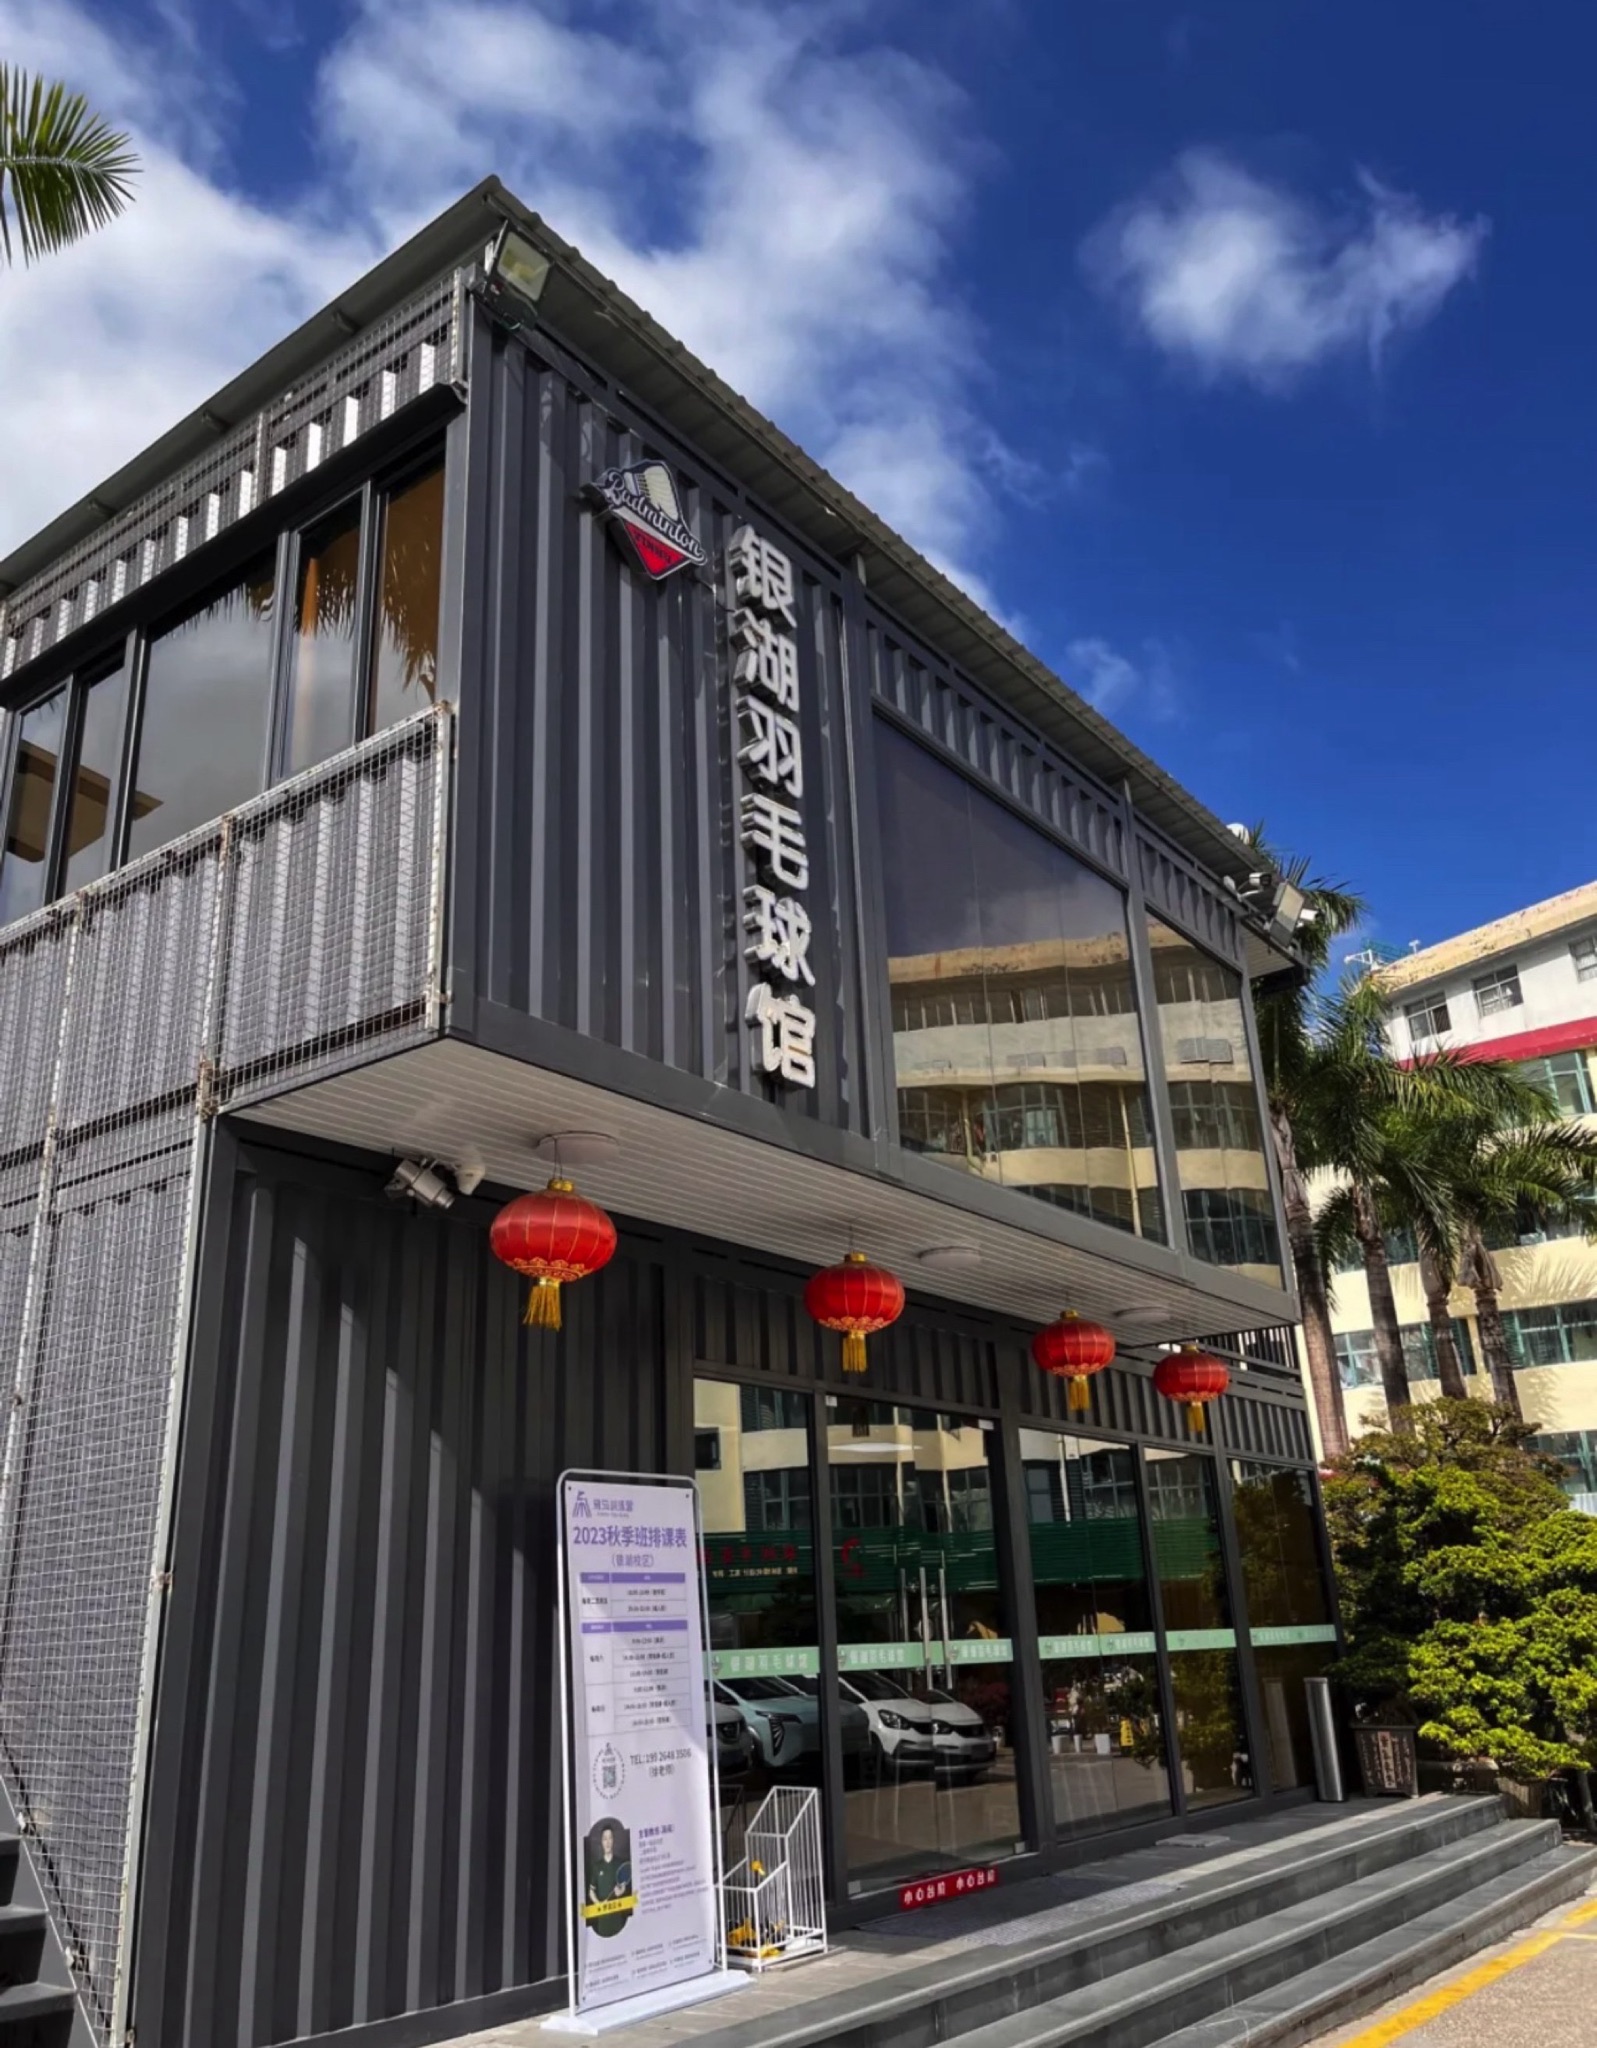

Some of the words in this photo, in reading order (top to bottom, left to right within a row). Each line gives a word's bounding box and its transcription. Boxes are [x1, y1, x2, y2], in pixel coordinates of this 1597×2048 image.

[602, 469, 708, 564] Badminton
[731, 523, 815, 1088] 银湖羽毛球馆
[573, 1525, 687, 1548] 2023秋季班排课表
